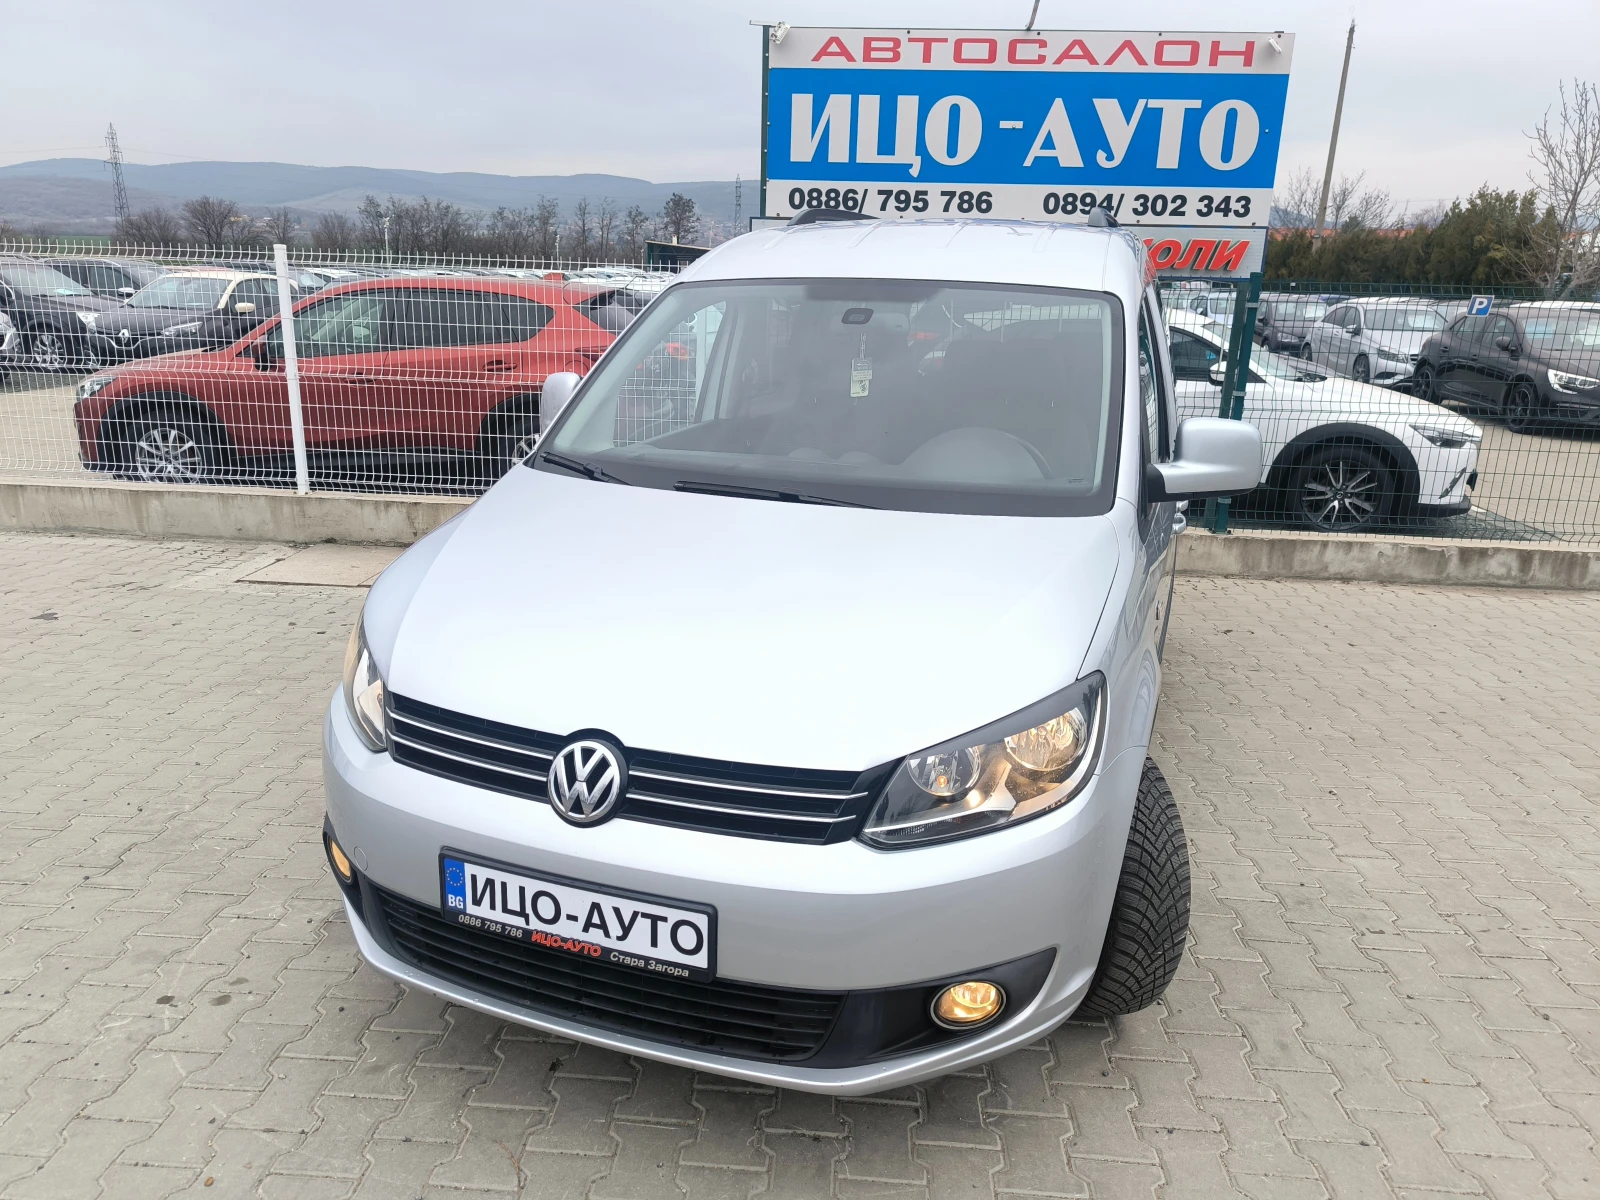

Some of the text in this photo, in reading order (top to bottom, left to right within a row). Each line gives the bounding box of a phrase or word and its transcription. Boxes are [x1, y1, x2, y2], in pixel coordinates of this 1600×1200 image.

[811, 36, 1255, 68] АВТОСАЛОН
[788, 187, 993, 214] 0886/ 795 786
[1043, 192, 1252, 218] 0894/ 302 343
[1143, 238, 1251, 271] ОЛИ
[1471, 297, 1488, 314] P
[447, 893, 464, 909] BG
[470, 873, 705, 956] ИЦО-АУТО
[458, 914, 689, 977] 0886 795 786 ИЦО-АУТО Стара Загора
